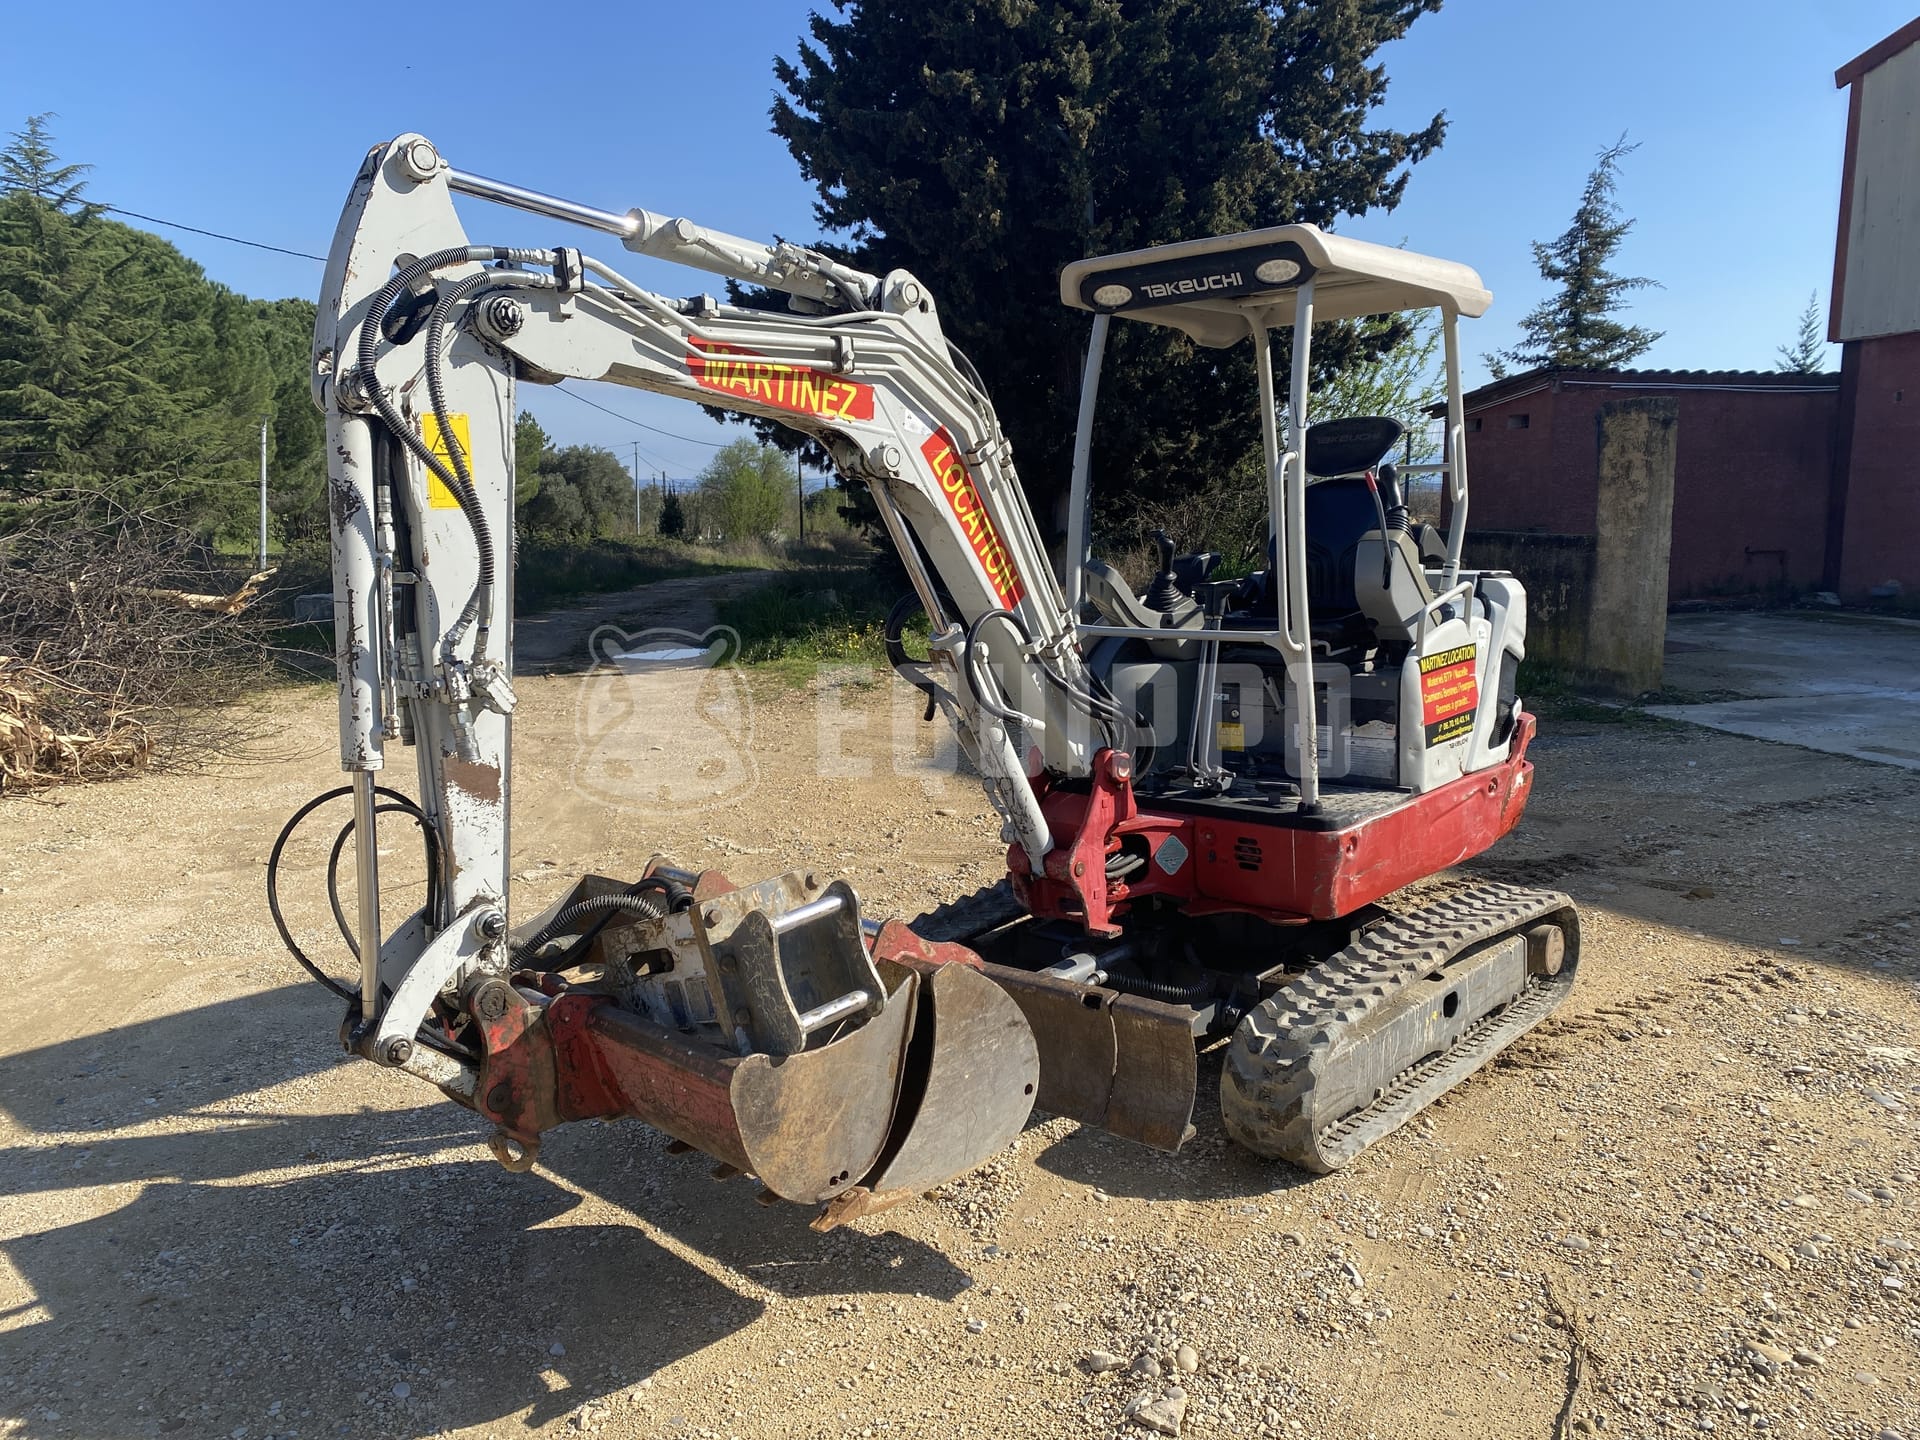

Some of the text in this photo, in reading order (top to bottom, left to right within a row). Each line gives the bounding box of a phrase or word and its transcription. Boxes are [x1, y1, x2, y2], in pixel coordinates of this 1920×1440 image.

[1140, 271, 1243, 298] TAKEUCHI
[704, 344, 857, 421] MARTINEZ
[932, 446, 1018, 596] LOCATION
